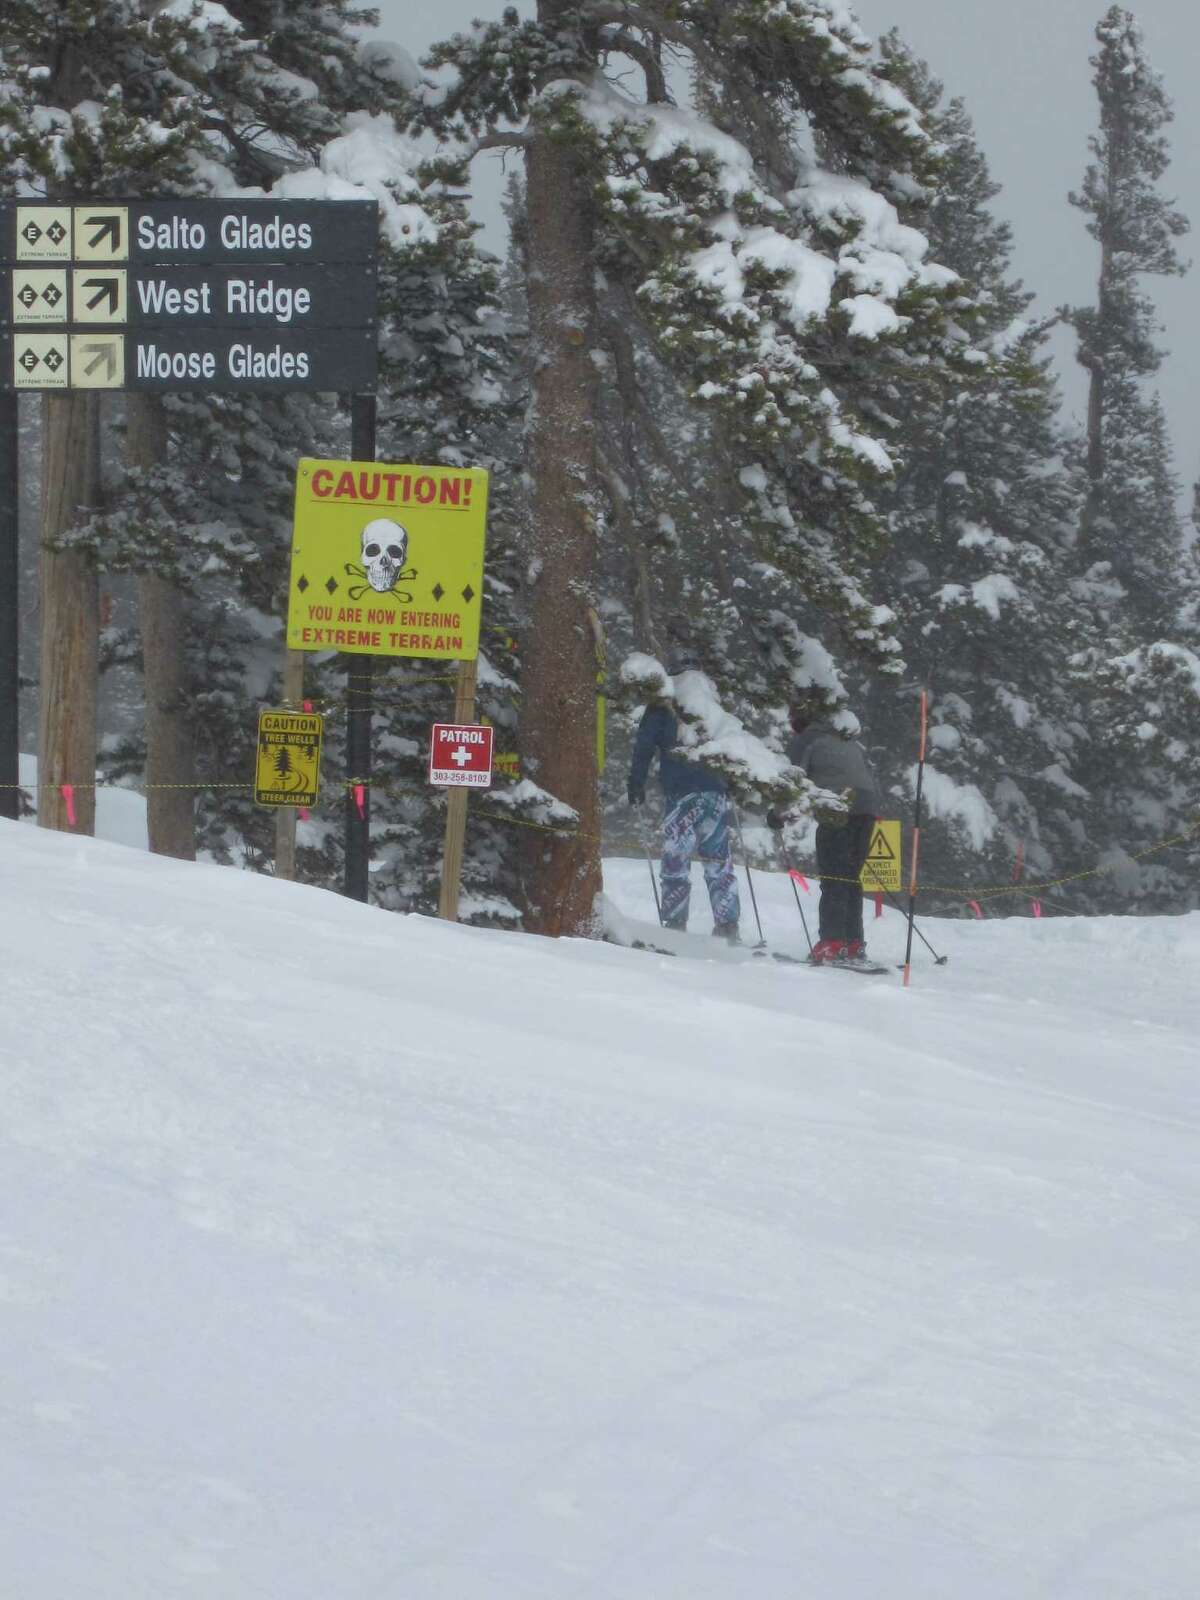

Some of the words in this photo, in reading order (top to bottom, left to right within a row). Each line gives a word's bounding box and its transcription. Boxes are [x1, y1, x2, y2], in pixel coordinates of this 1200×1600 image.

[27, 227, 37, 239] E
[51, 227, 61, 239] X
[137, 215, 206, 250] Salto
[220, 215, 313, 250] Glades
[23, 290, 33, 302] E
[46, 289, 57, 301] X
[137, 280, 211, 315] West
[227, 279, 311, 323] Ridge
[24, 355, 34, 366] E
[48, 354, 58, 366] X
[137, 344, 216, 378] Moose
[228, 343, 309, 378] Glades
[311, 469, 473, 507] CAUTION!
[308, 604, 333, 622] YOU
[337, 607, 362, 624] ARE
[367, 609, 396, 625] NOW
[400, 611, 461, 629] ENTERING
[302, 627, 382, 648] EXTREME
[389, 632, 463, 651] TERRAIN
[264, 717, 317, 732] CAUTION
[265, 734, 286, 744] TREE
[287, 735, 315, 745] WELLS
[439, 729, 485, 744] PATROL
[260, 793, 284, 802] STEER
[286, 794, 311, 803] CLEAR
